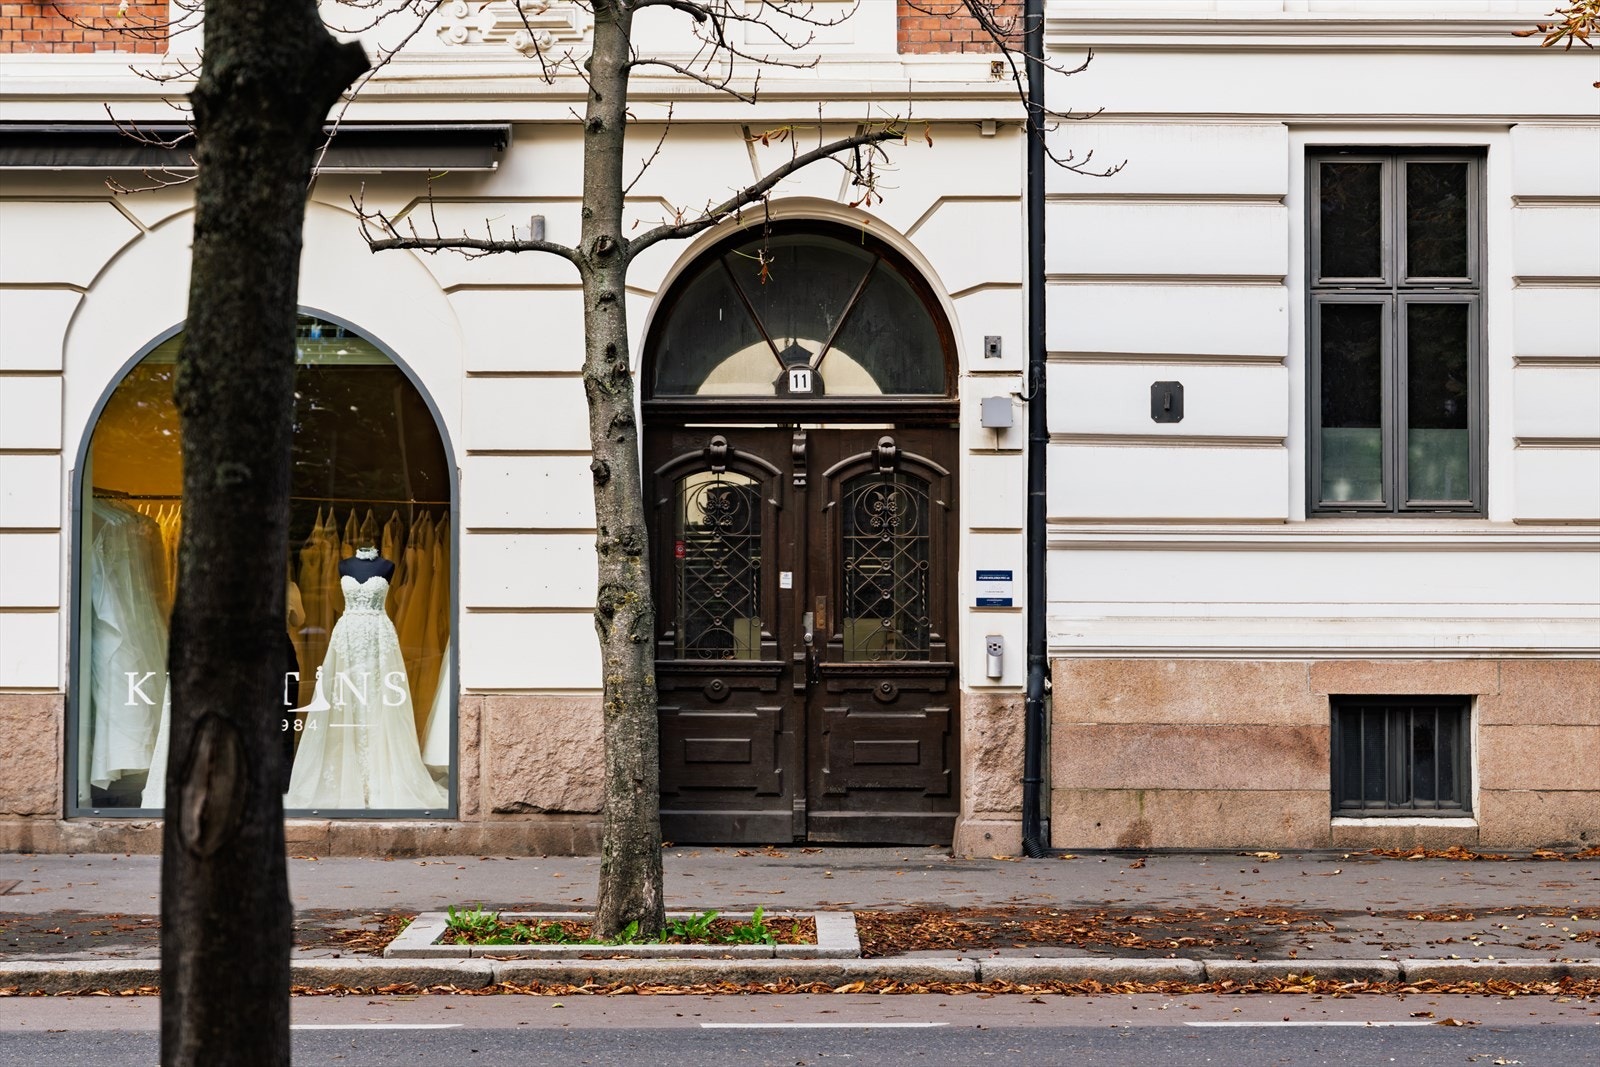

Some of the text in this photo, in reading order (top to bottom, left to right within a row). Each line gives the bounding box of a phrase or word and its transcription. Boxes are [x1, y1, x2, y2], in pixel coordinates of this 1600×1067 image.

[793, 374, 807, 389] 11
[123, 666, 408, 713] KTINS
[279, 718, 319, 732] 984
